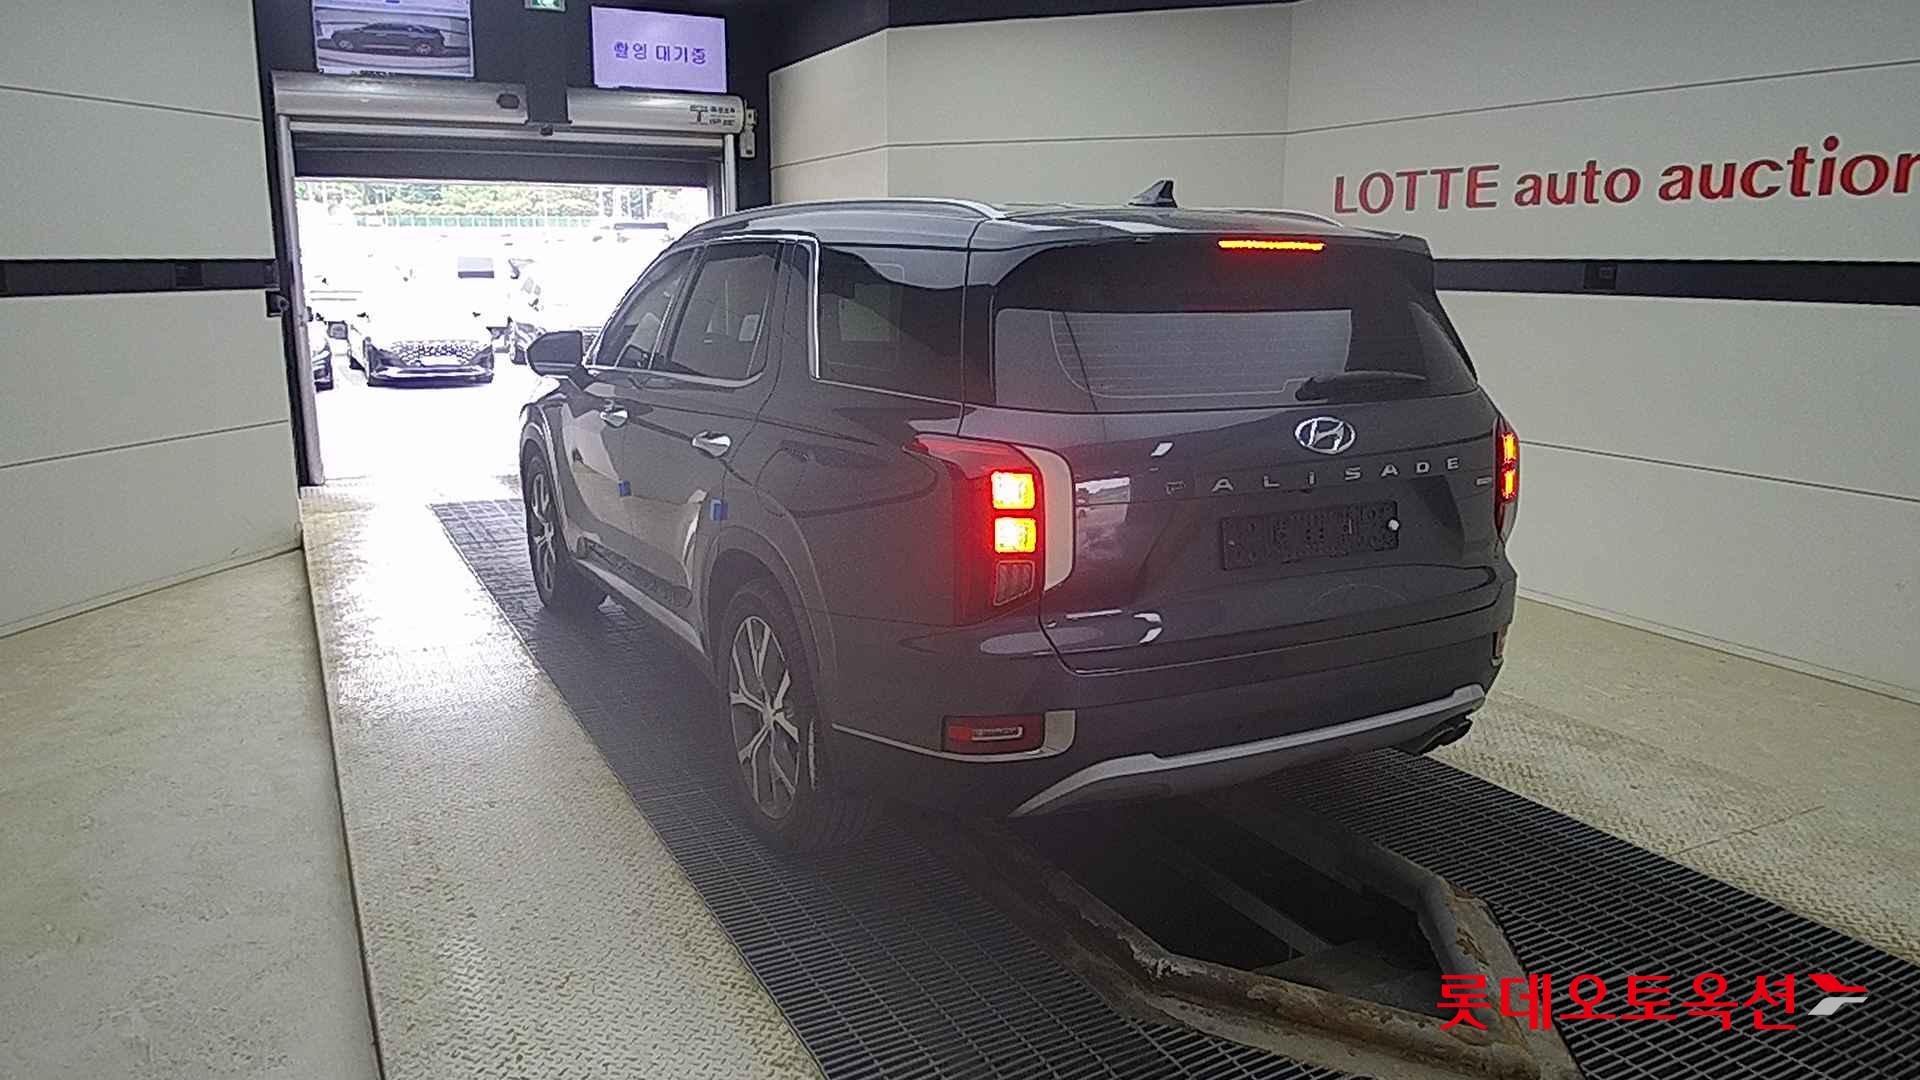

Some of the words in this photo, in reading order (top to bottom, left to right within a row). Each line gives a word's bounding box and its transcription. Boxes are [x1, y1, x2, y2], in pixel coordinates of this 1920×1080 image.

[655, 45, 706, 65] 대기중
[1334, 164, 1500, 214] LOTTE
[1514, 159, 1641, 205] auto
[1166, 457, 1460, 494] PALISADE
